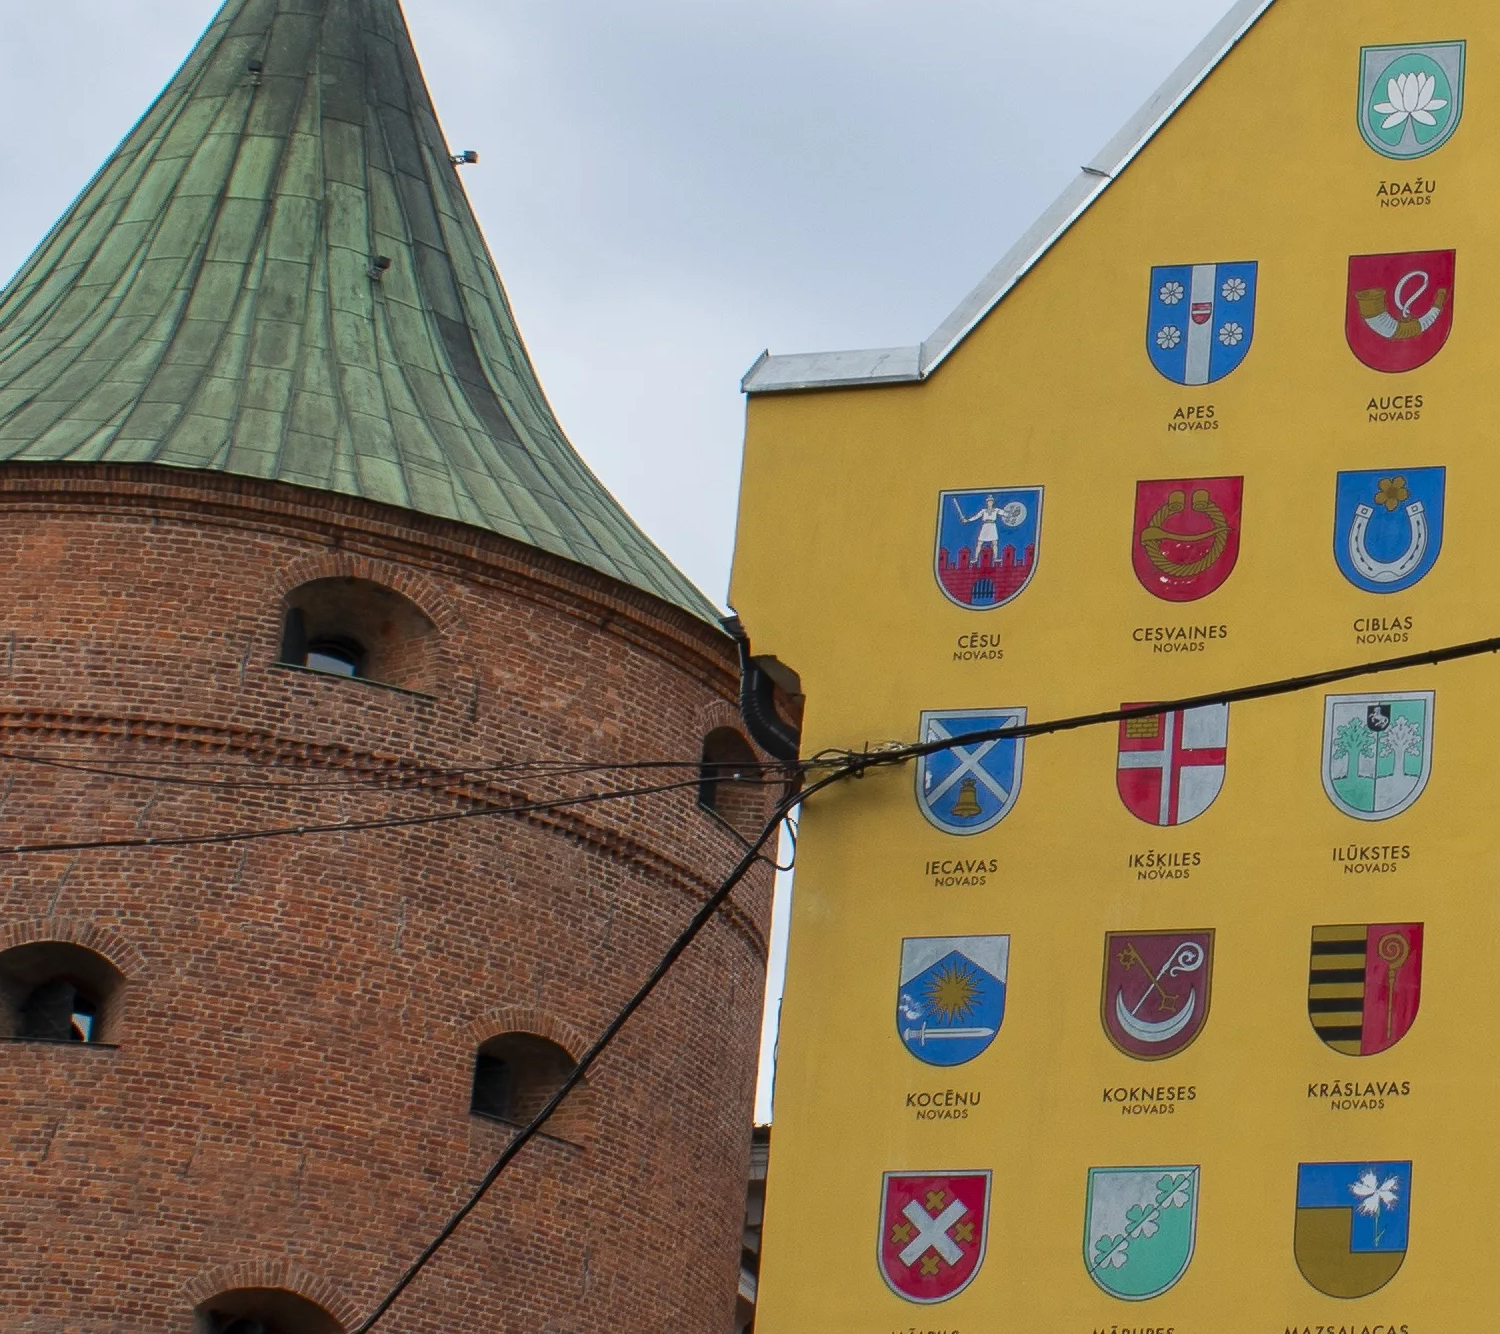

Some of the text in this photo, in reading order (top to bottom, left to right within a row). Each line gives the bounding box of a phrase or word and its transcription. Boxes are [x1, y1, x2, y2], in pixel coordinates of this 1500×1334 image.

[1375, 176, 1436, 198] ĀDAŽU
[1365, 394, 1424, 411] AUCES
[1172, 404, 1215, 420] APES
[1132, 624, 1228, 642] CESVAINES
[1353, 615, 1413, 633] CIBLAS
[957, 631, 1001, 649] CĒSU
[1128, 849, 1201, 872] IKŠĶILES
[1332, 844, 1411, 862] ILŪKSTES
[925, 858, 998, 876] IECAVAS
[905, 1088, 981, 1108] KOCĒNU
[1102, 1085, 1197, 1103] KOKNESES
[1307, 1079, 1411, 1099] KRĀSLAVAS
